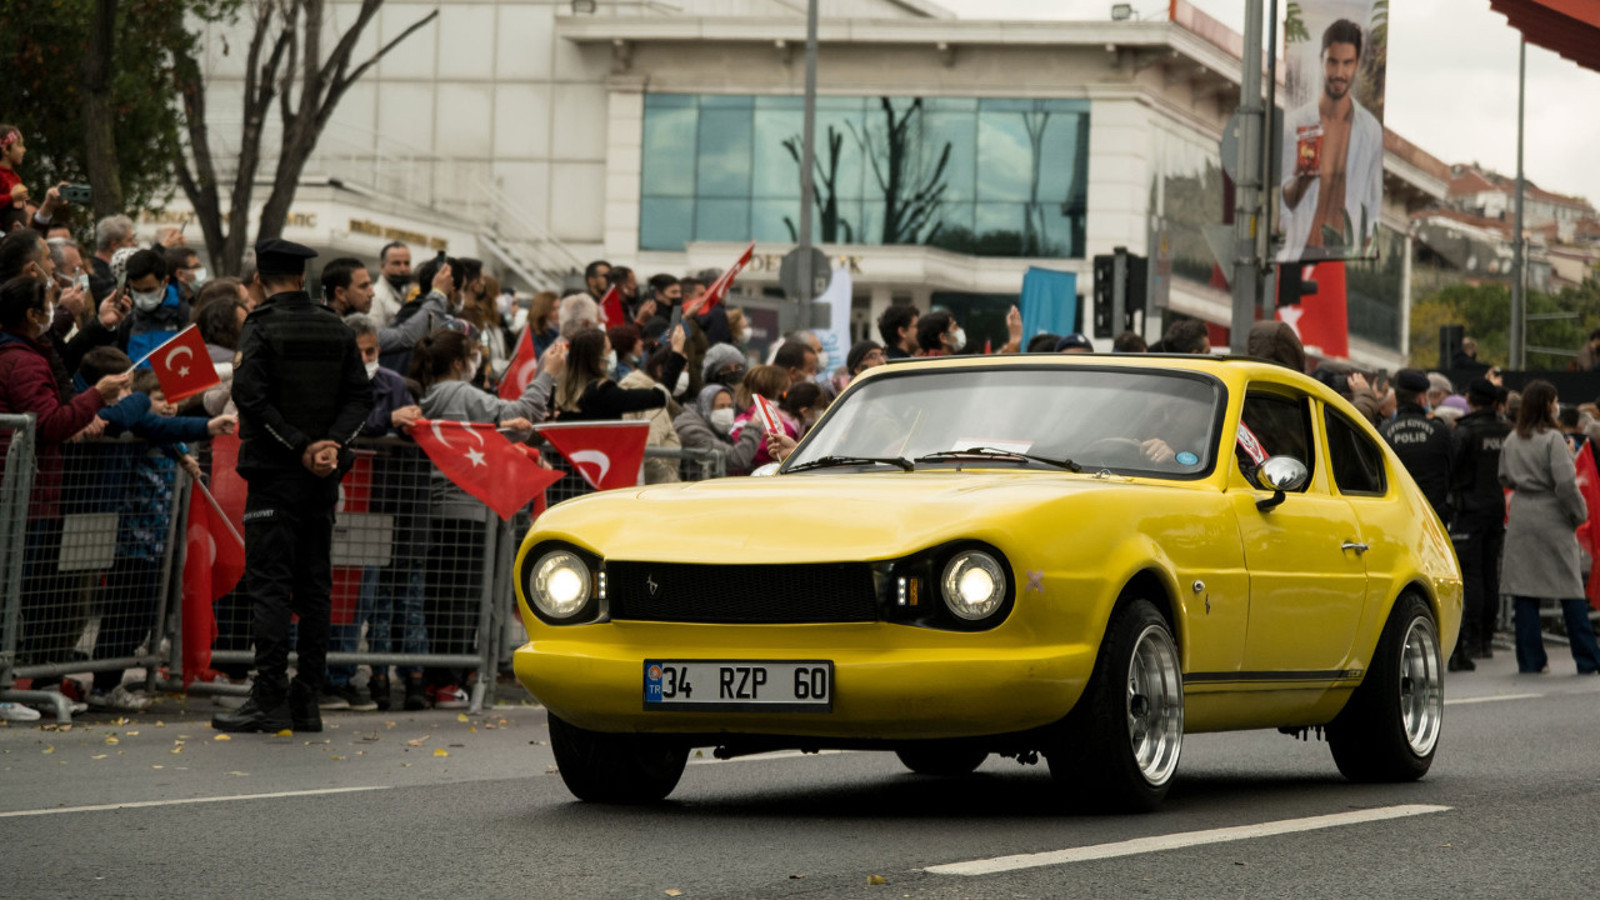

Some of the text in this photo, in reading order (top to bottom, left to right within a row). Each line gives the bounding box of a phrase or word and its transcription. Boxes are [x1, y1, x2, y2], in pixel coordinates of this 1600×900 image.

[650, 685, 661, 694] TR
[662, 667, 826, 699] 34 RZP 60
